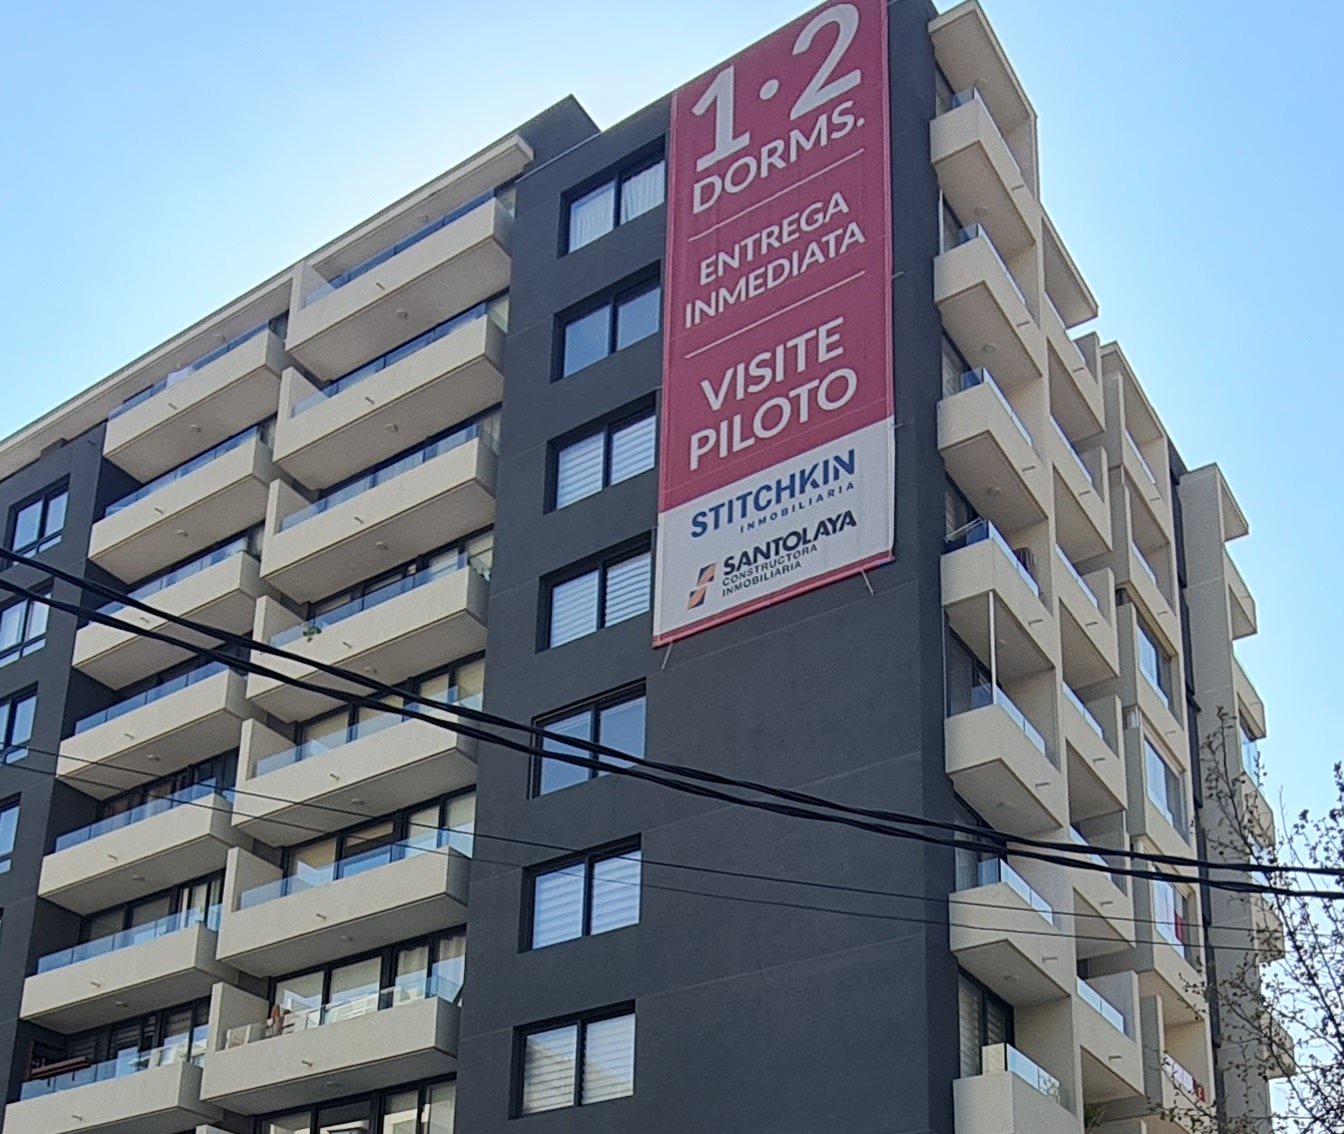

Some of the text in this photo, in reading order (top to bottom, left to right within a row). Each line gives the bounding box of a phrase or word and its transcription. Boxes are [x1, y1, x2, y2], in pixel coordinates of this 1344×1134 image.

[692, 100, 865, 215] DORMS.
[684, 221, 866, 329] INMEDIATA
[699, 191, 850, 286] ENTREGA
[700, 316, 844, 412] VISITE
[689, 367, 857, 472] PILOTO
[690, 448, 856, 539] STITCHKIN
[739, 482, 855, 534] INMOBILIARIA
[721, 560, 802, 598] INMOBILIARIA
[722, 543, 818, 587] CONSTRUCTORA
[723, 509, 858, 576] SANTOLAYA
